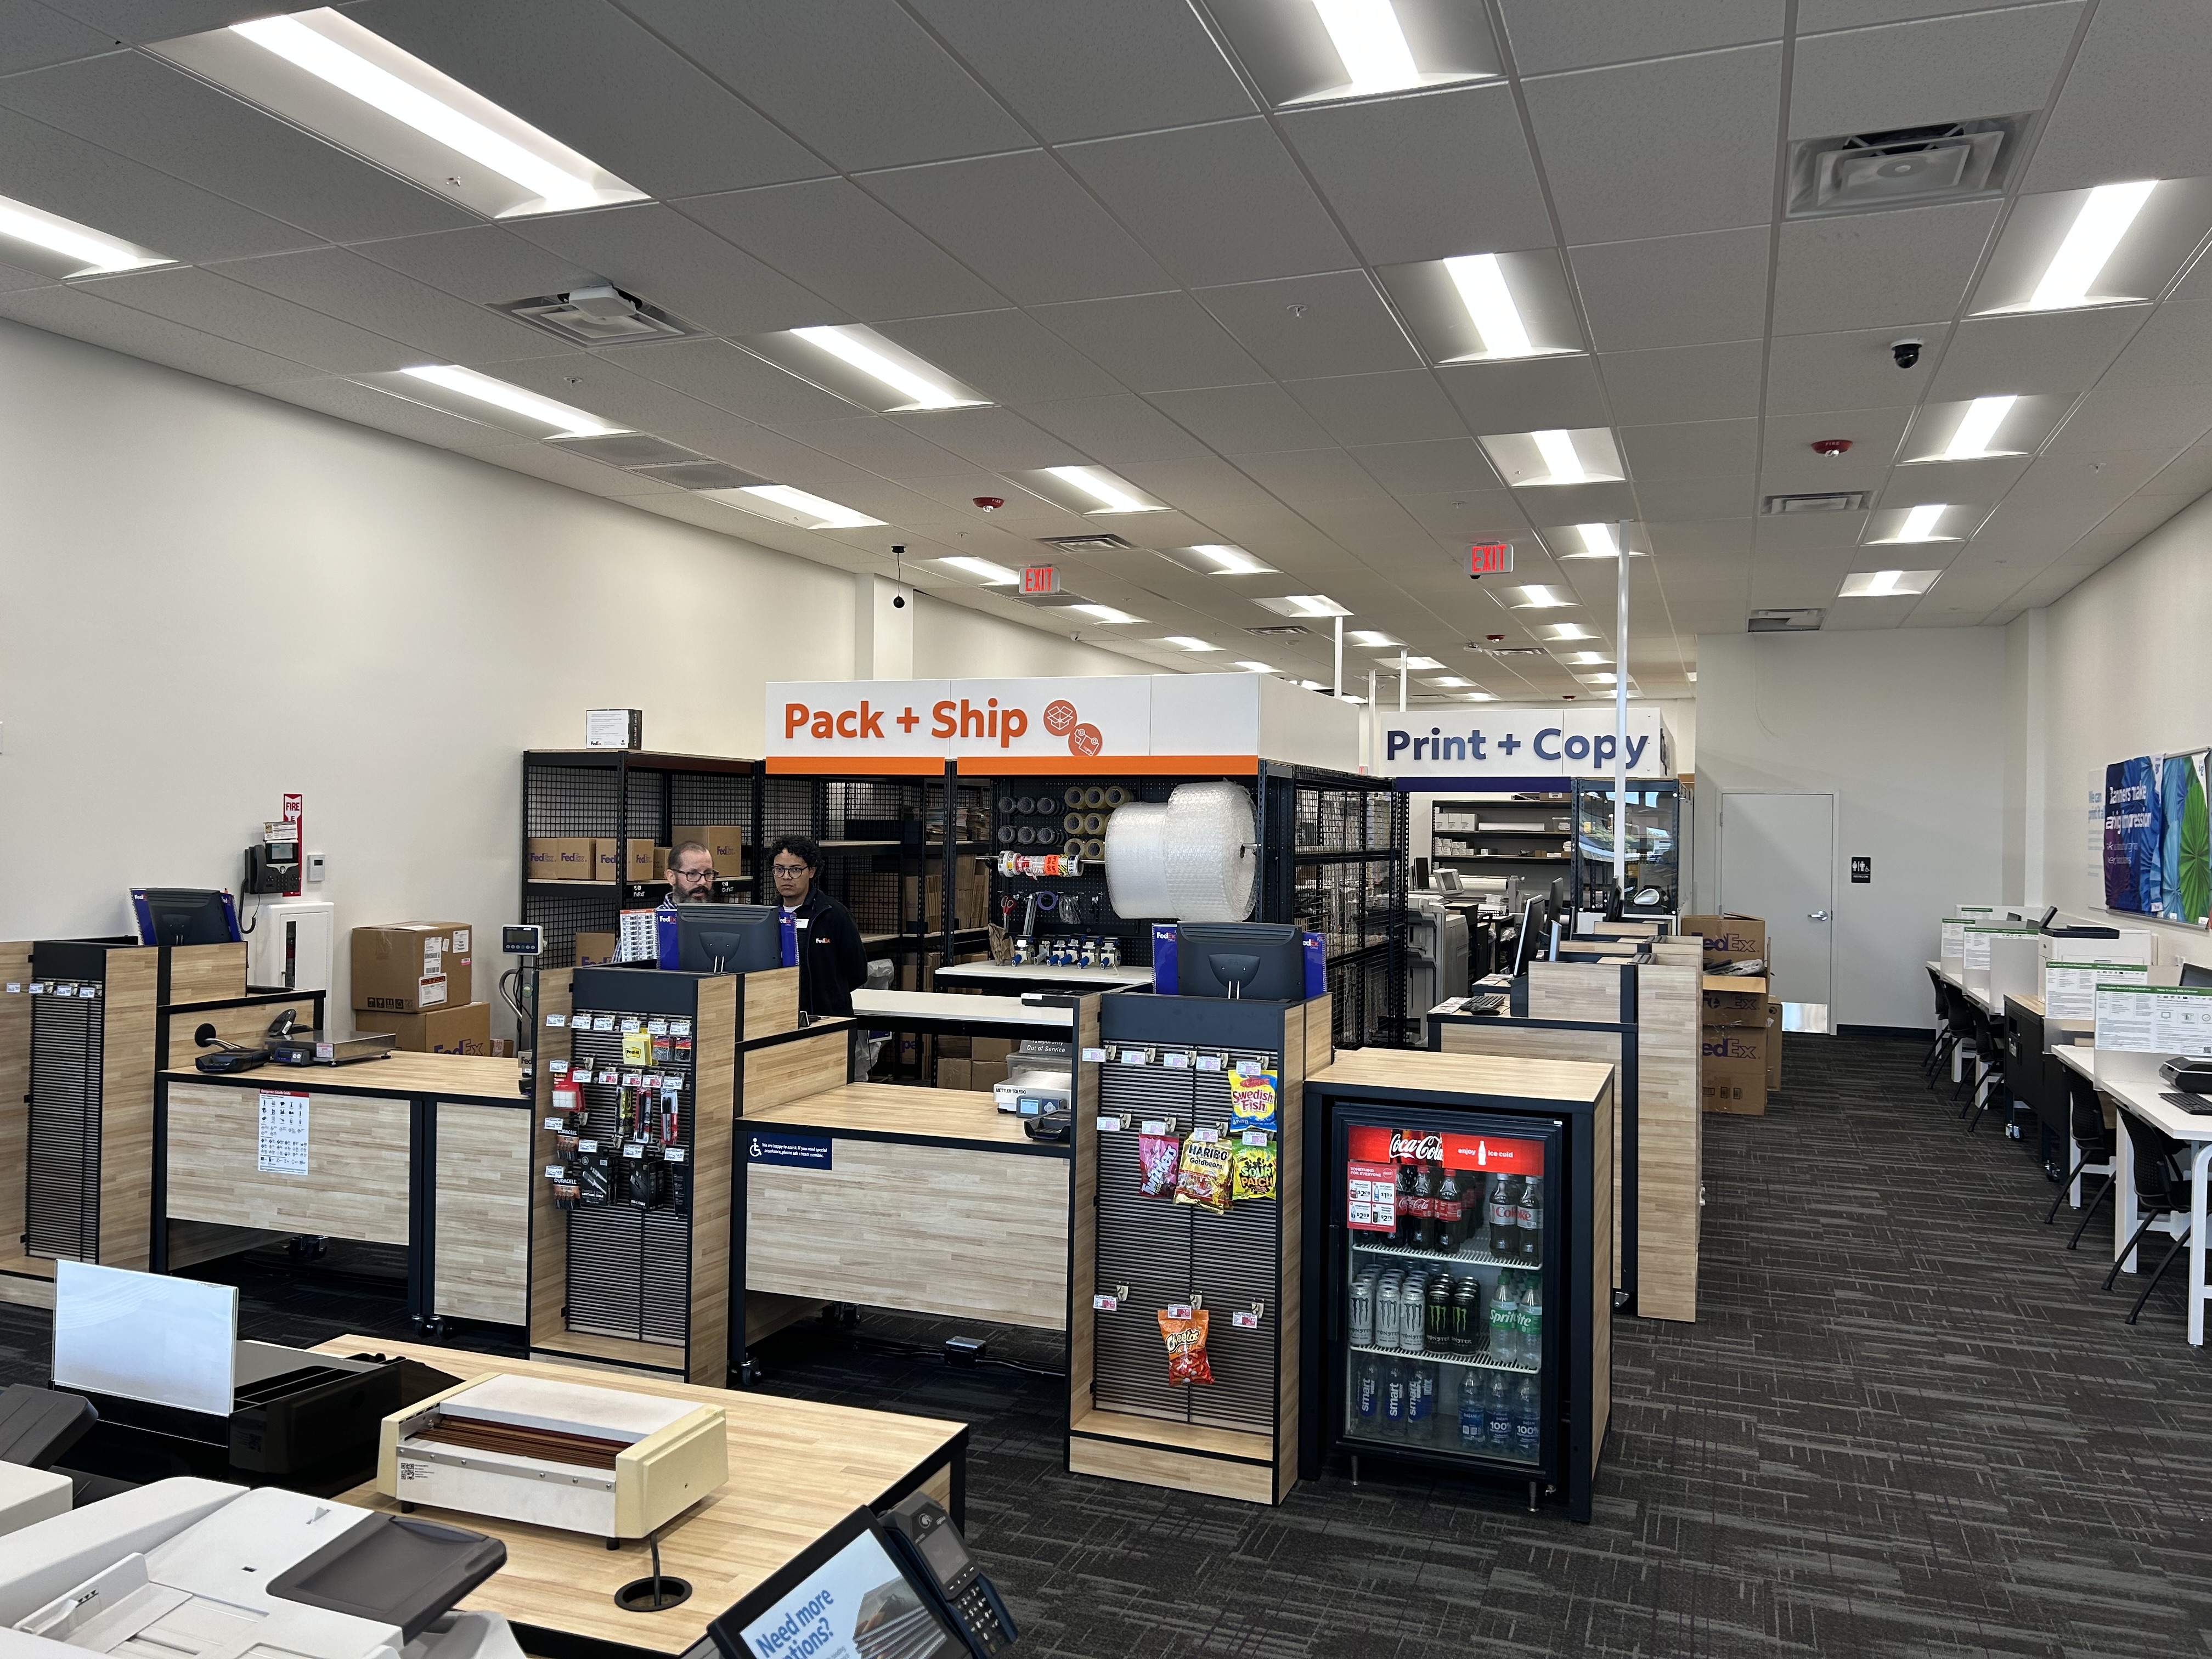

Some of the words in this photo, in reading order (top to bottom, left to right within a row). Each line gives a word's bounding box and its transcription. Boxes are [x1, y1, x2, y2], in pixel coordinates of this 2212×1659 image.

[1472, 544, 1507, 572] EXIT
[1025, 568, 1053, 591] EXIT
[785, 701, 885, 738] Pack
[896, 707, 920, 733] +
[931, 697, 1028, 748] Ship
[1387, 727, 1487, 760] Print
[1498, 733, 1521, 755] +
[1533, 727, 1649, 769] Copy
[286, 802, 300, 811] FIRE
[531, 852, 554, 862] FedEx
[561, 852, 585, 862] FedEx
[716, 845, 734, 855] FedEx
[601, 854, 617, 864] Fed
[636, 854, 653, 864] FedEx
[1302, 939, 1319, 947] edEx
[1691, 932, 1756, 953] edEx
[1703, 992, 1756, 1010] FeEx
[1702, 1038, 1757, 1059] edEx
[521, 1056, 532, 1065] Fed
[1233, 1088, 1273, 1104] Swedish
[1241, 1099, 1266, 1111] Fish
[1189, 1144, 1228, 1161] HARIBO
[1389, 1133, 1443, 1161] Coca-Cola
[1458, 1148, 1476, 1156] enjoy
[1189, 1157, 1223, 1170] Goldbears
[1241, 1166, 1272, 1178] SOUR
[1241, 1176, 1273, 1187] PATCH
[1166, 1329, 1200, 1353] Cheetos
[1362, 1378, 1370, 1412] smart
[1390, 1383, 1399, 1417] smart
[1409, 1381, 1418, 1416] smart
[1489, 1421, 1512, 1430] 100%
[755, 1612, 800, 1659] Need
[795, 1589, 834, 1628] more
[781, 1617, 834, 1659] tions?
